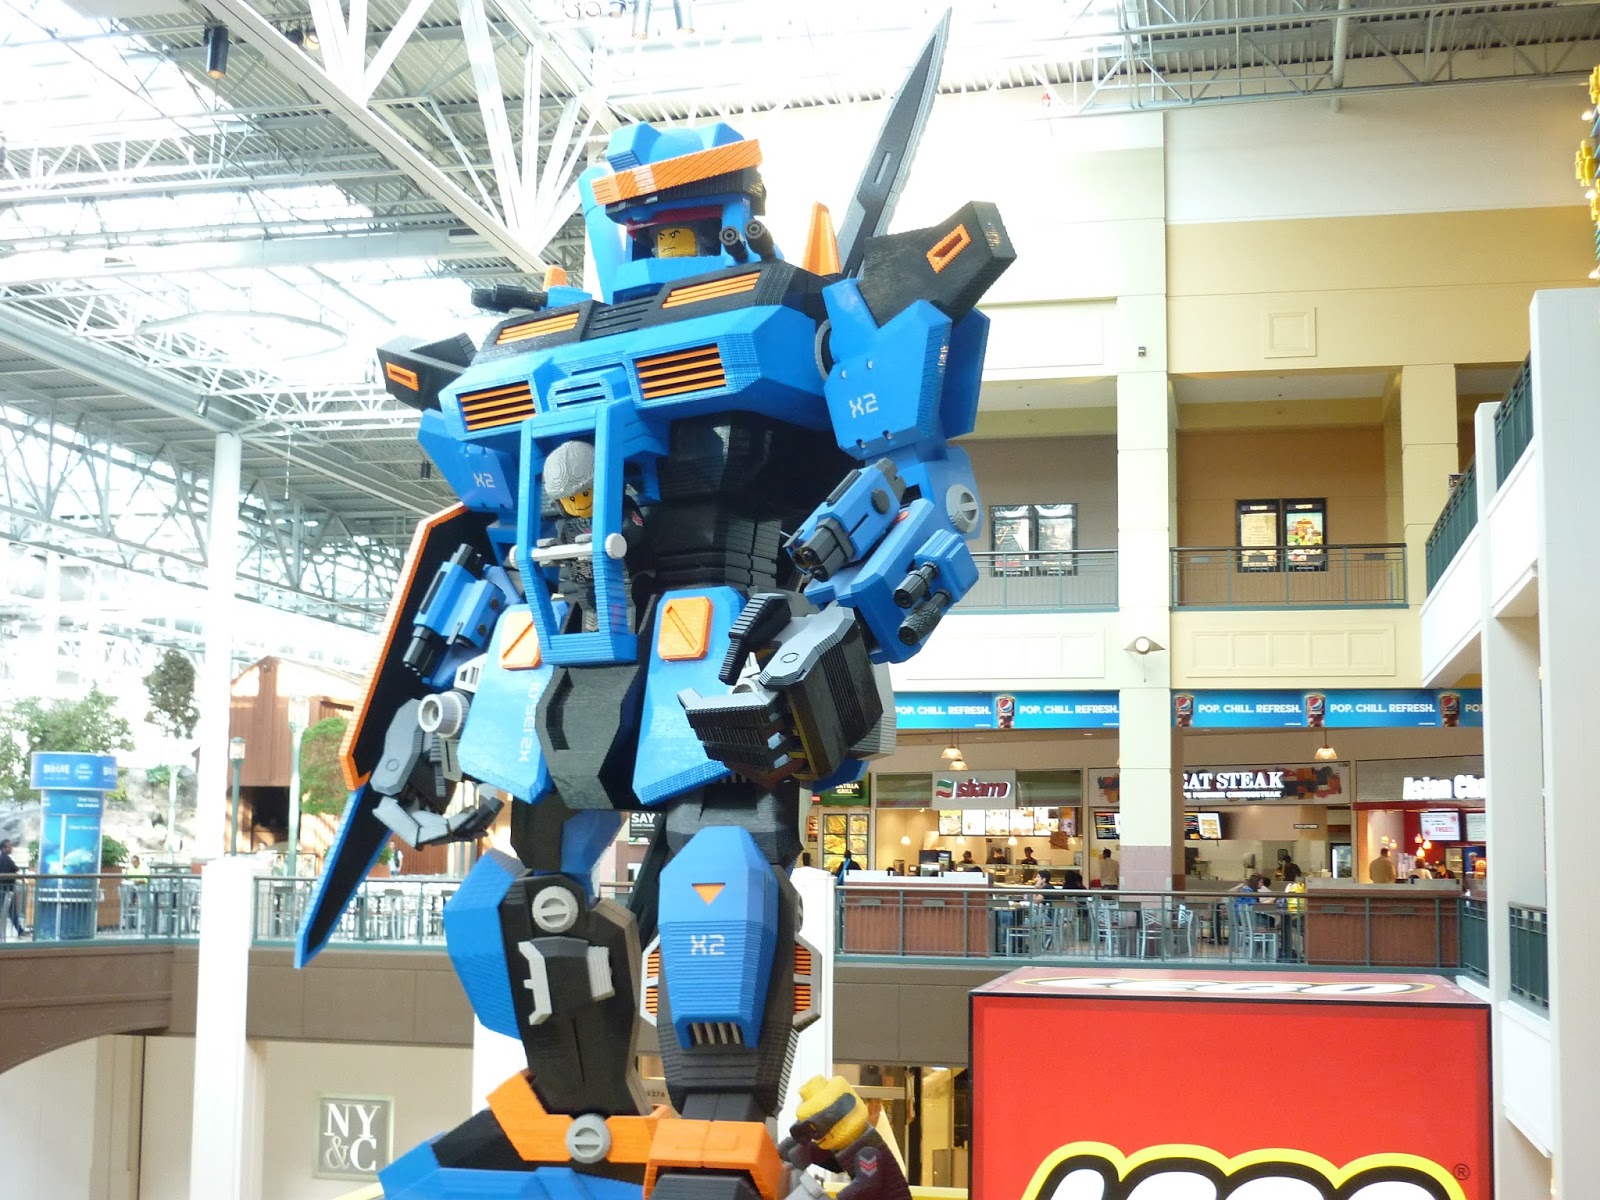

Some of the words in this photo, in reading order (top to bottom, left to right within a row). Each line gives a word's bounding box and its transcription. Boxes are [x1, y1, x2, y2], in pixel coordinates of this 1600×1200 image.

[849, 393, 878, 419] X2
[473, 473, 496, 489] X2
[948, 705, 991, 715] REFRESH.
[1019, 705, 1042, 714] POP.
[1043, 705, 1073, 714] CHILL.
[1198, 704, 1222, 714] POP.
[1223, 704, 1254, 714] CHILL.
[1256, 704, 1302, 714] REFRESH.
[1330, 704, 1355, 713] POP.
[1356, 704, 1387, 713] CHILL.
[1389, 703, 1435, 713] REFRESH.
[1216, 771, 1285, 789] STEAK
[1403, 777, 1452, 800] Asian
[631, 812, 655, 823] SAY
[691, 934, 726, 957] X2
[323, 1103, 381, 1138] NY
